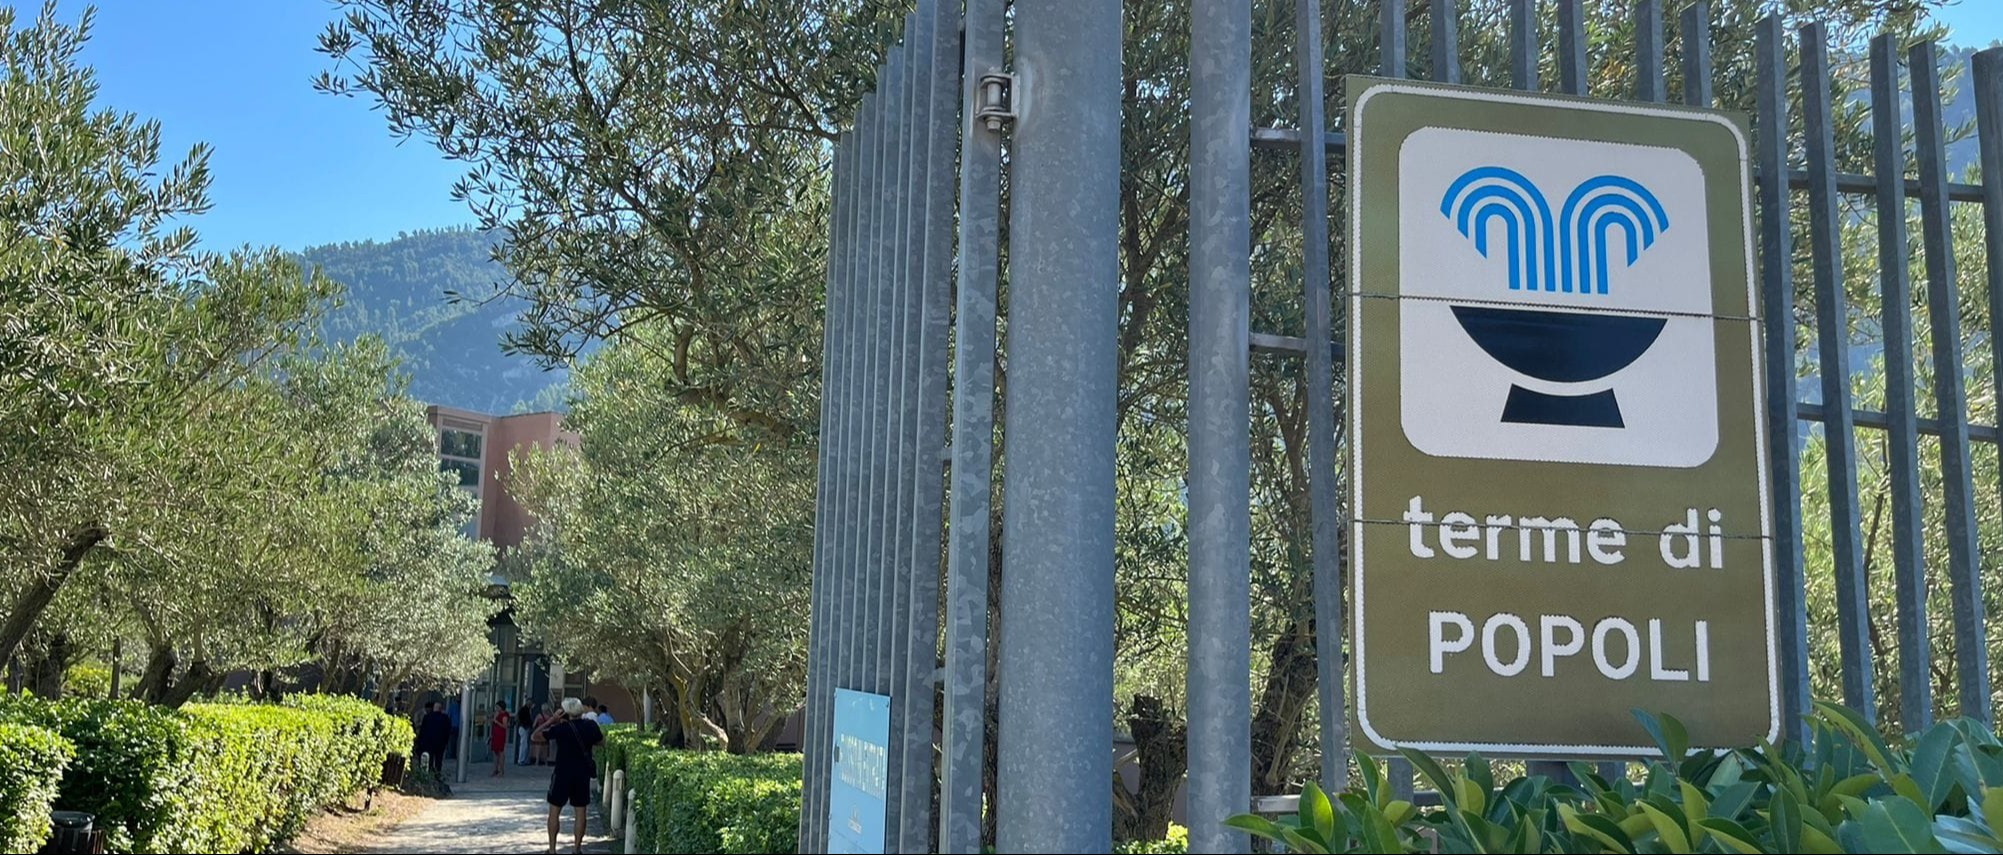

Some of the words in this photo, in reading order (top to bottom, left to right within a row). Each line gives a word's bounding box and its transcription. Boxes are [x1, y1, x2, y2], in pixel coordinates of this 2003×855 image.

[1403, 495, 1626, 565] terme
[1659, 508, 1722, 568] di
[1429, 611, 1709, 681] POPOLI
